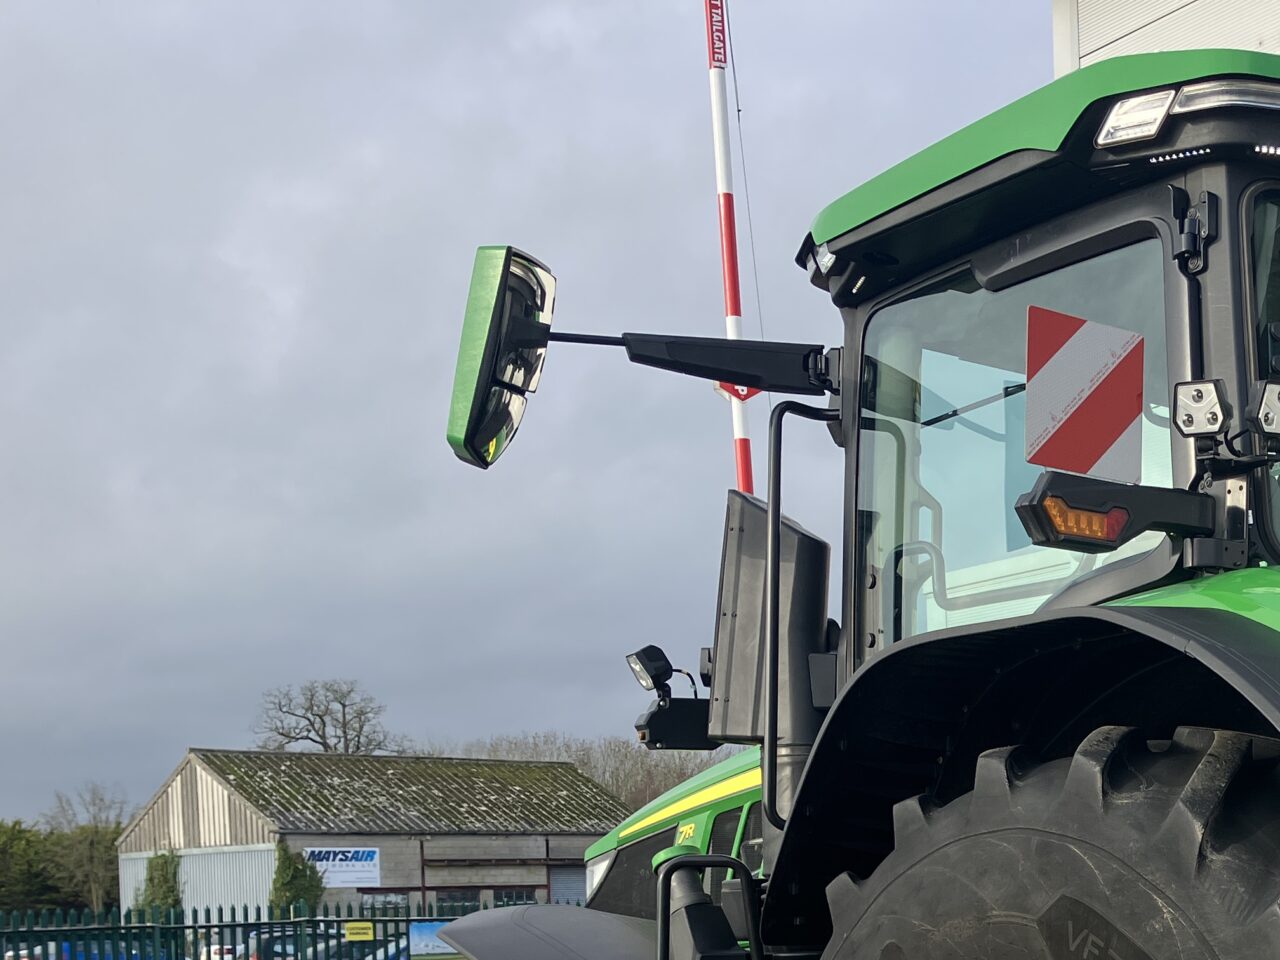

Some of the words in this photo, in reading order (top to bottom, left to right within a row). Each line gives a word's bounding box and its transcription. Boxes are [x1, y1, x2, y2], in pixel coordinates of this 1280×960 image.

[711, 9, 725, 62] TAILGATE
[678, 823, 695, 844] 7R
[307, 850, 377, 862] MAYSAIR
